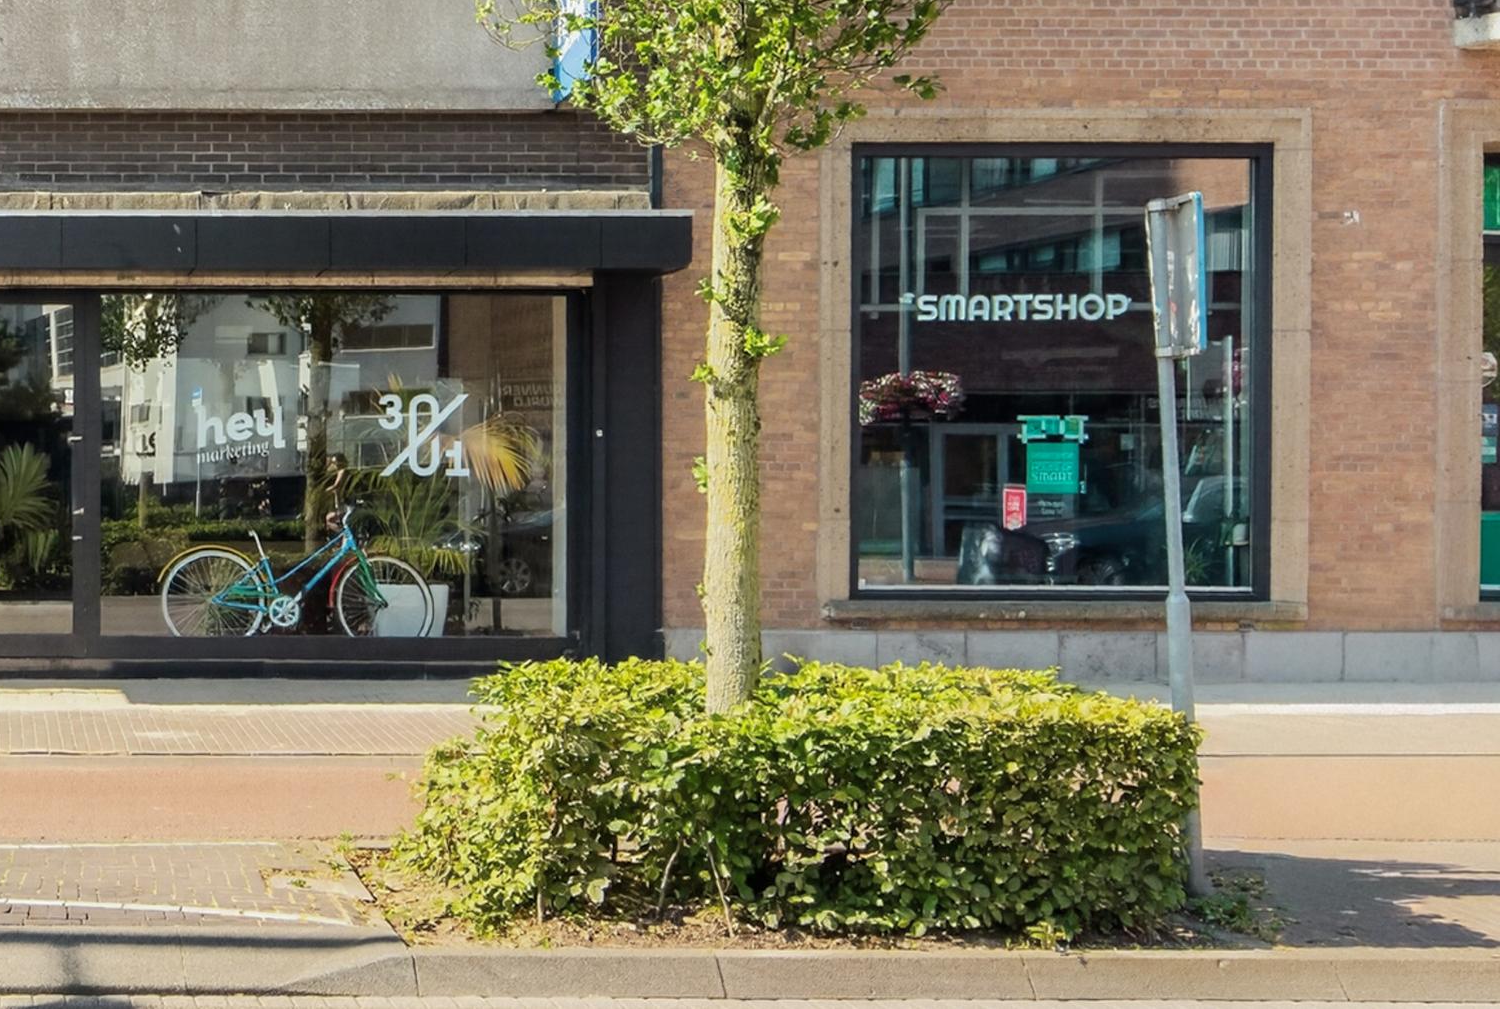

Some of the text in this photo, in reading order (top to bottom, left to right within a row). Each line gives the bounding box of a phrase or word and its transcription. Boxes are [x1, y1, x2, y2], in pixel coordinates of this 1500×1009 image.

[916, 292, 1130, 322] SMARTSHOP
[195, 404, 286, 449] hey
[196, 441, 270, 464] marketing
